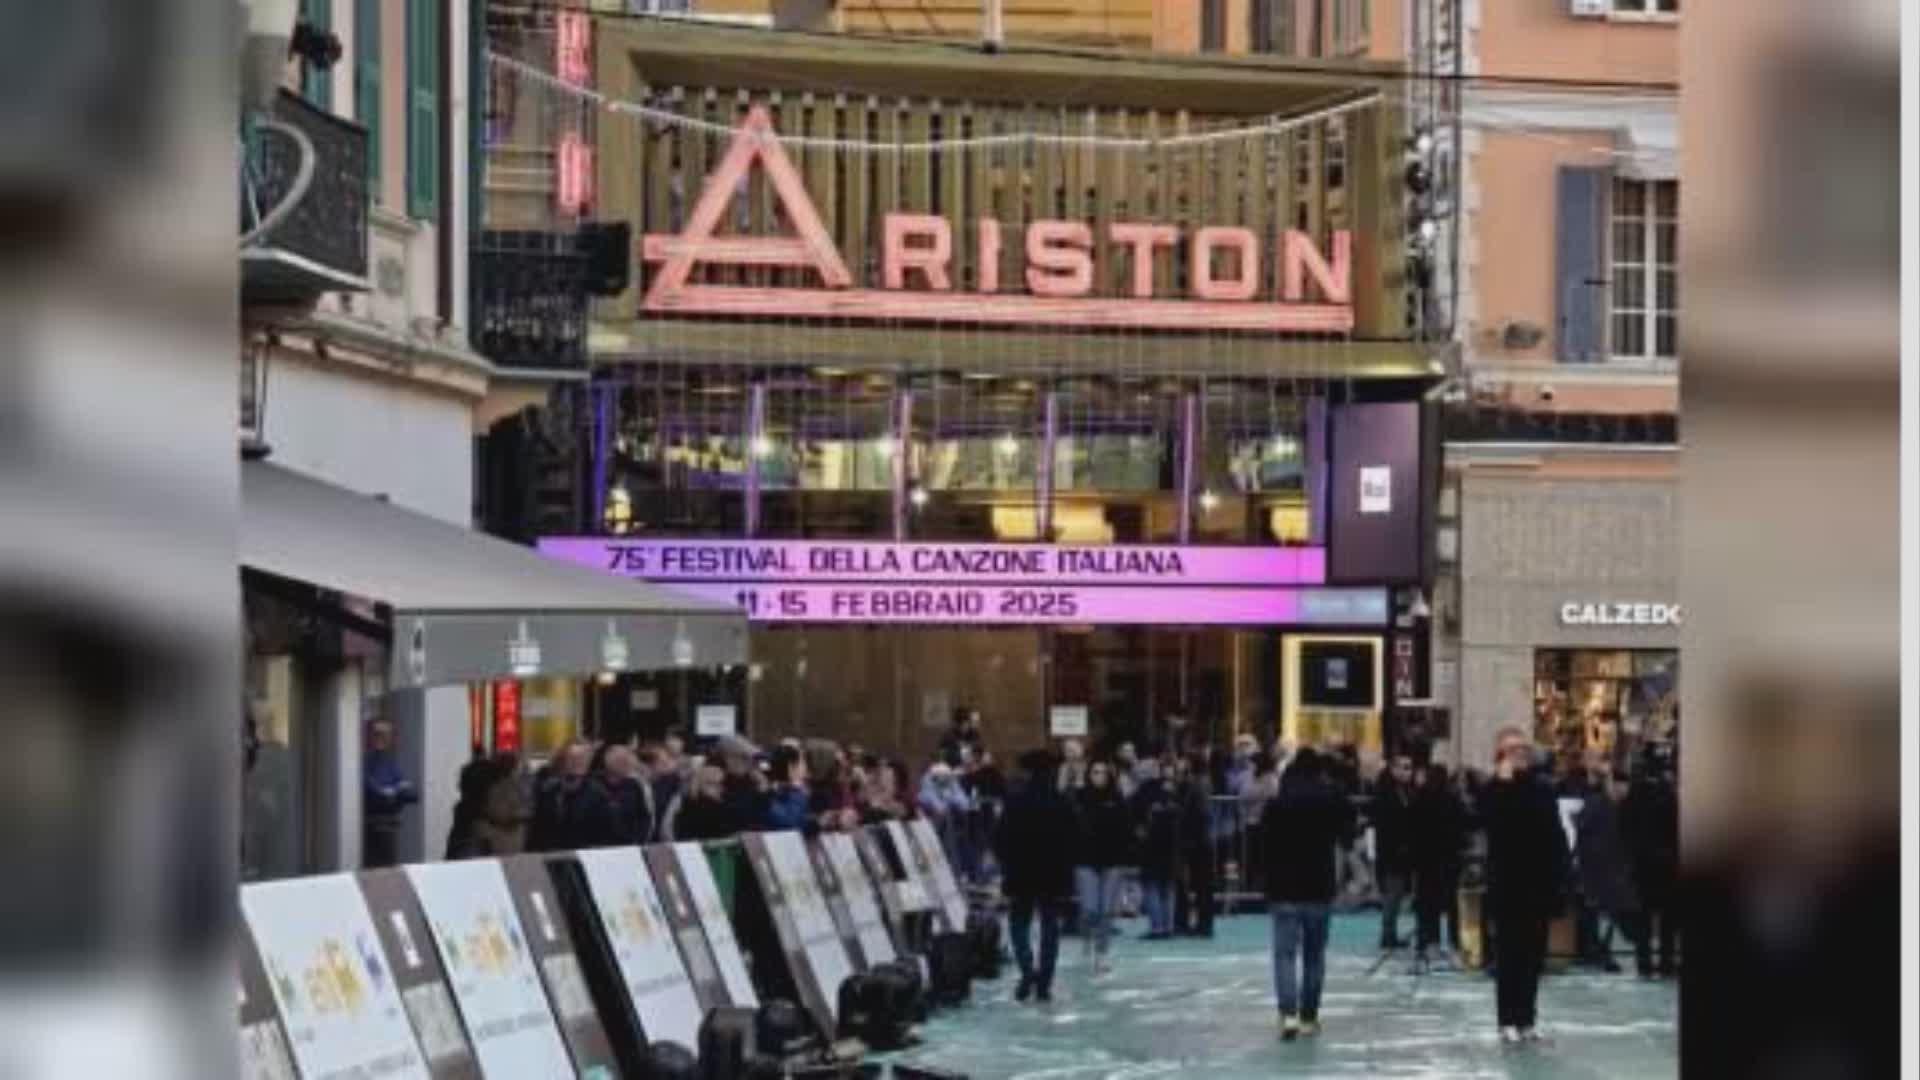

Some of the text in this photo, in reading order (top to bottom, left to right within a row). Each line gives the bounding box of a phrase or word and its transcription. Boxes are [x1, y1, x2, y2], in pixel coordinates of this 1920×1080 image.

[643, 103, 1353, 329] ARISTON
[661, 547, 797, 573] FESTIVAL
[810, 548, 901, 574] DELLA
[912, 550, 1047, 575] CANZONE
[1057, 550, 1184, 574] ITALIANA
[832, 592, 983, 618] FEBBRAIO
[1000, 592, 1078, 618] 2025
